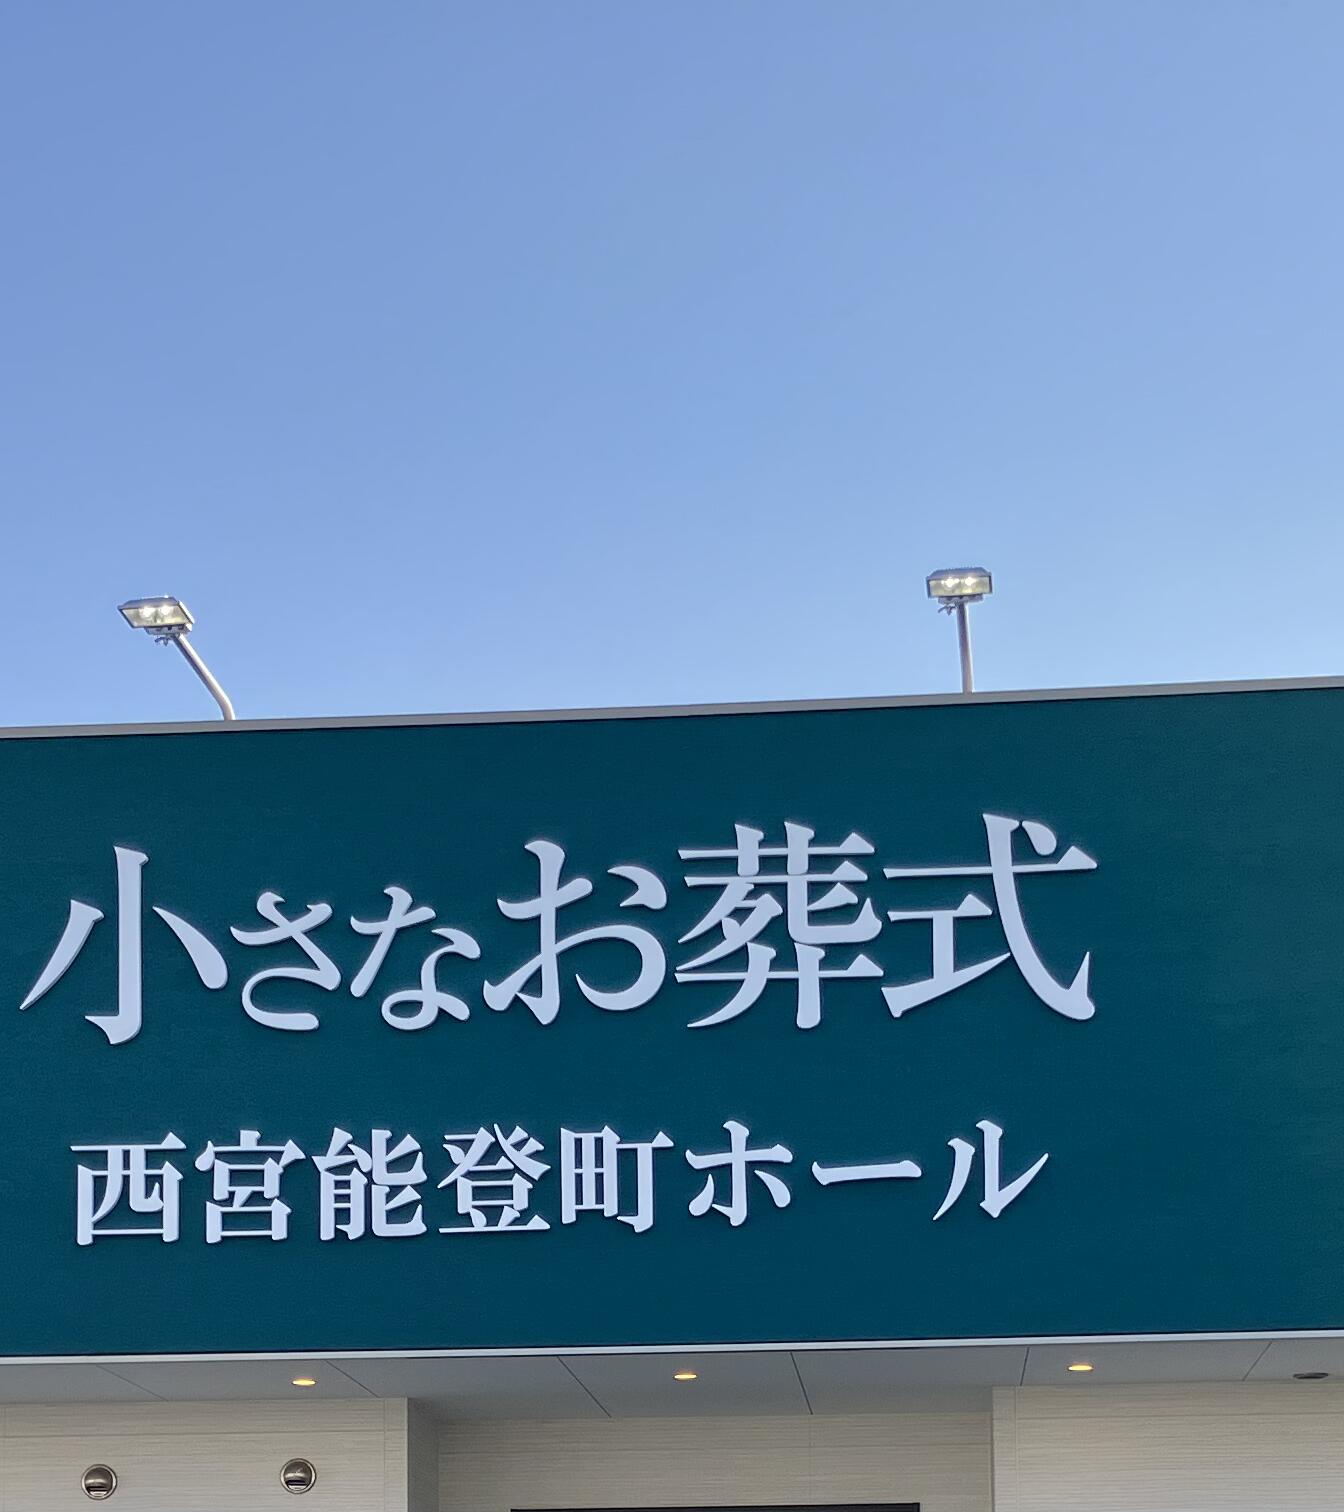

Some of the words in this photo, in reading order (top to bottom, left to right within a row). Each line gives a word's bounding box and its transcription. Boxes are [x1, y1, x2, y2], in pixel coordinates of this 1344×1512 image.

[19, 813, 1098, 1046] 小さなお葬式
[70, 1119, 1049, 1247] 西宮能登町ホール
